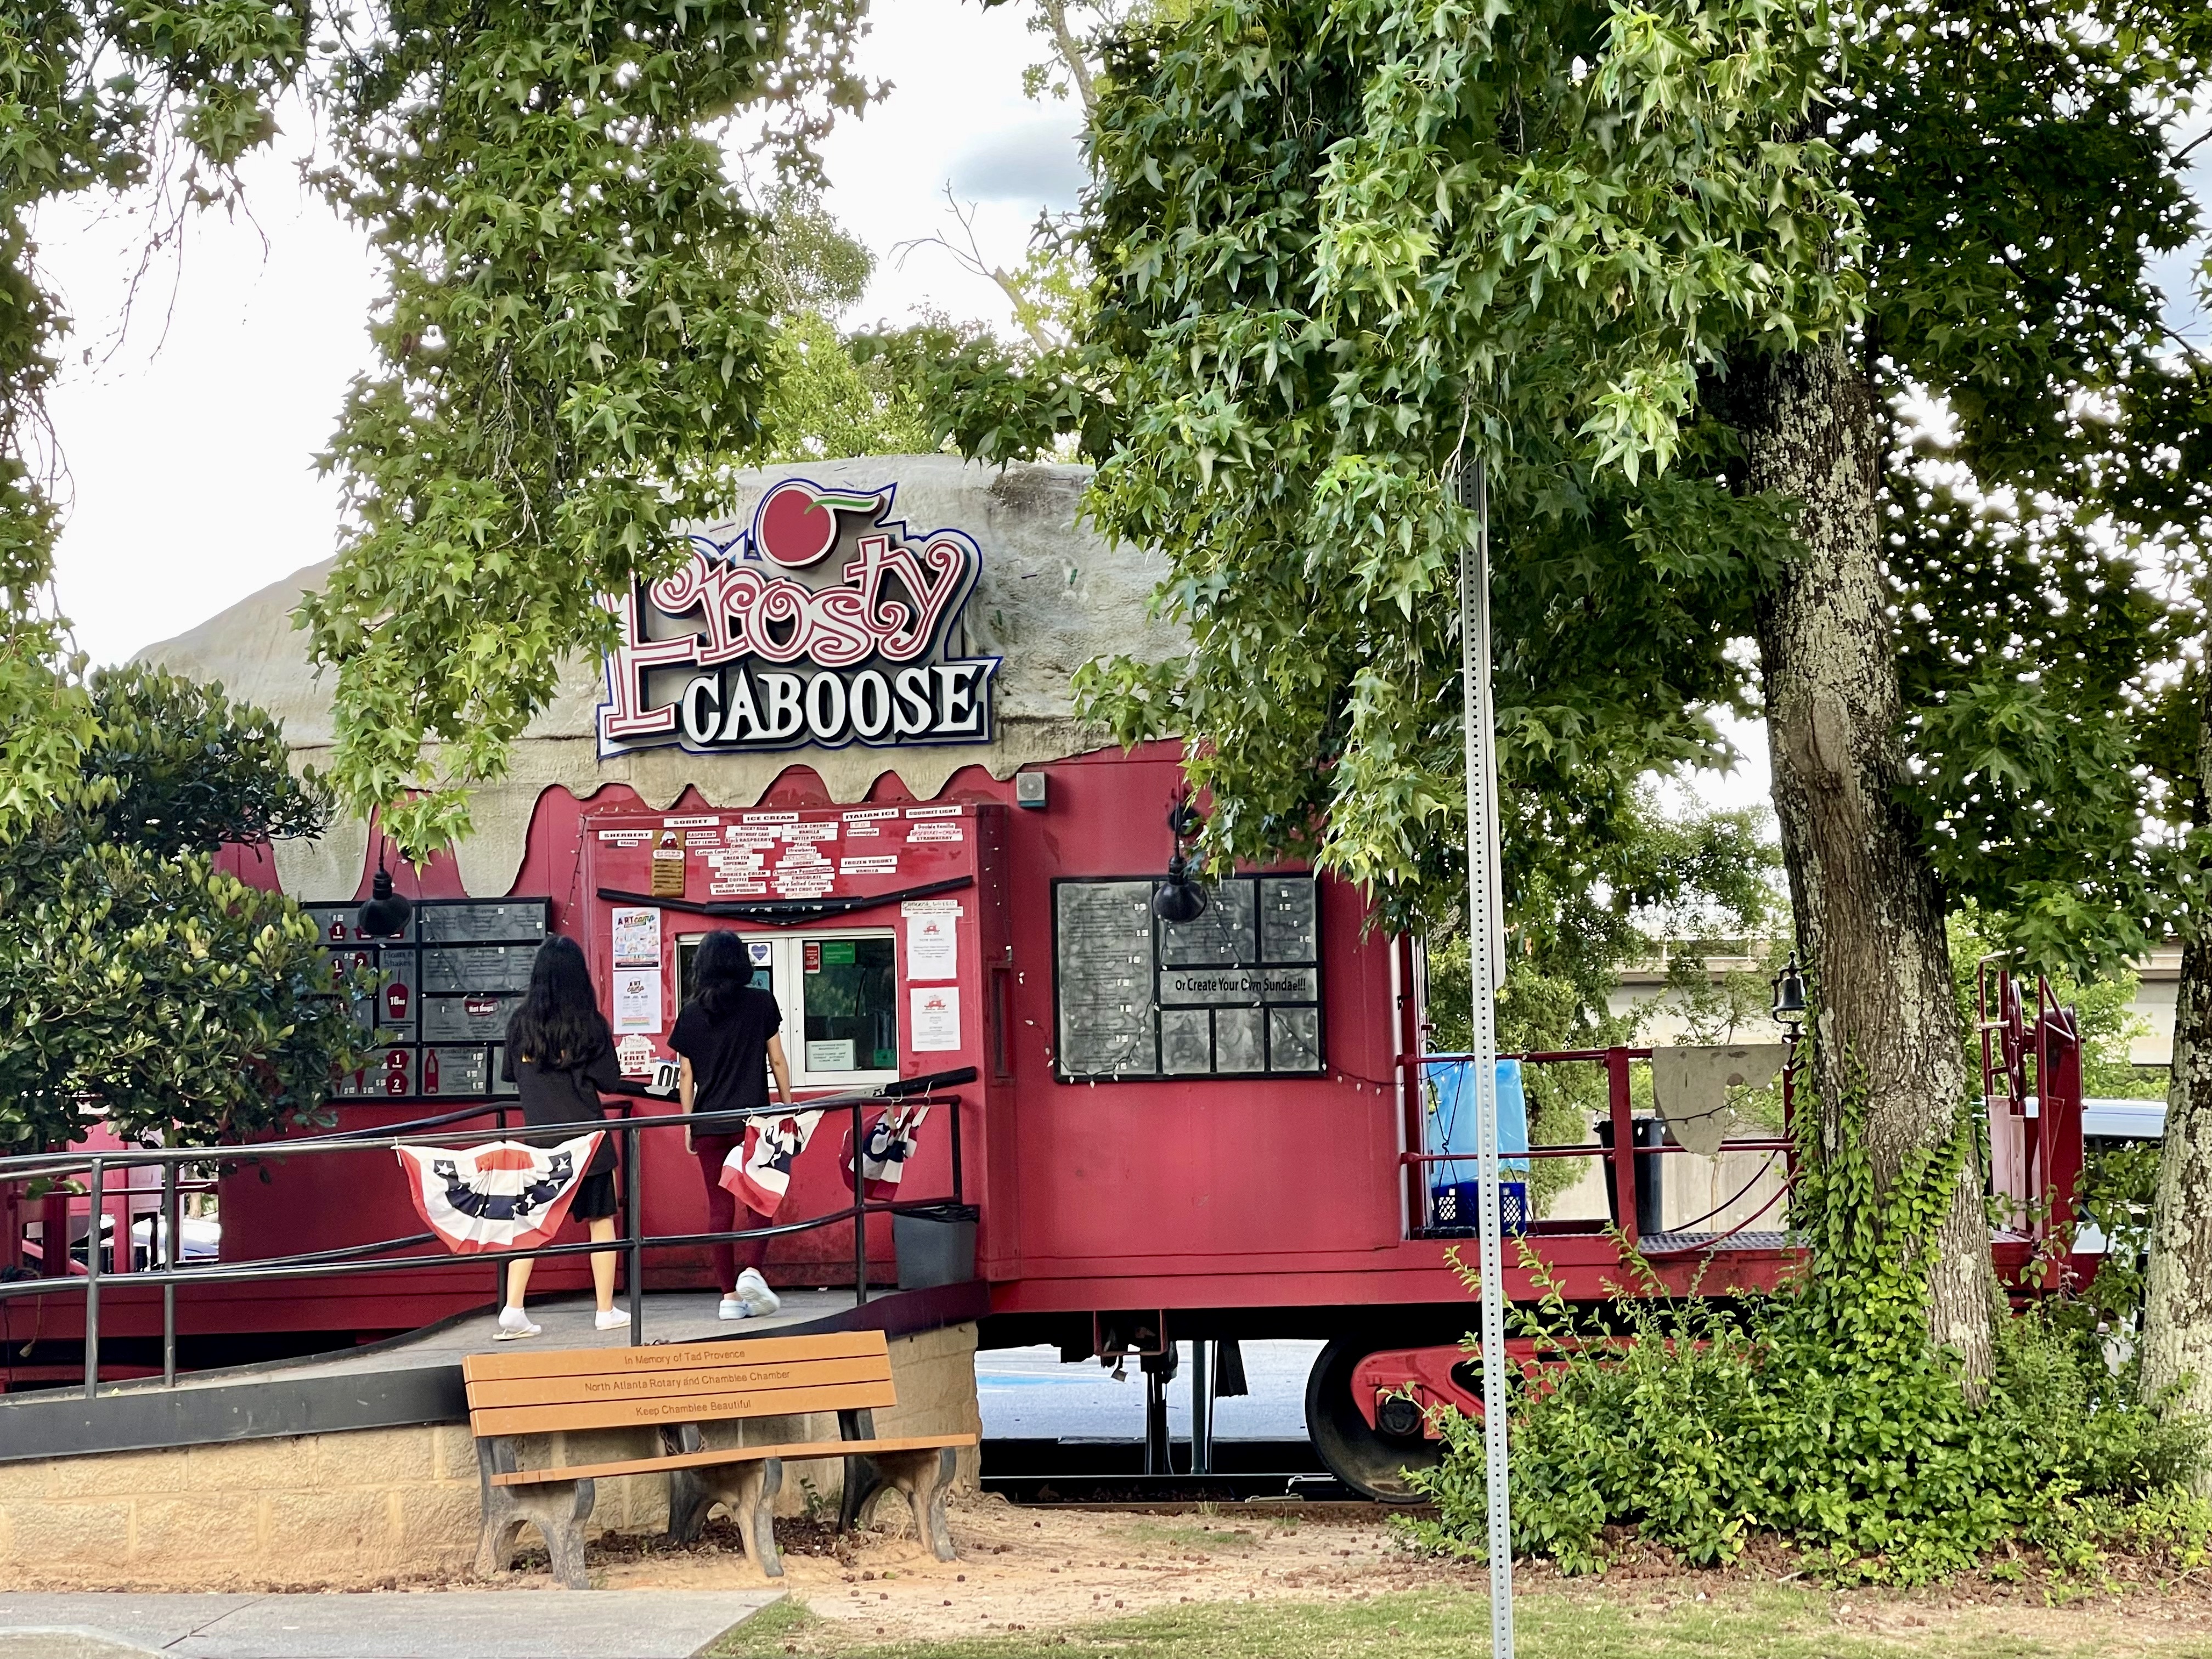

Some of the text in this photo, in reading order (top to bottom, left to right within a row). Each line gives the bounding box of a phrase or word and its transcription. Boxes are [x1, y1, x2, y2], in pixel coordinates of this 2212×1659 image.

[606, 534, 966, 740] Frosty
[681, 663, 982, 744] CABOOSE
[618, 915, 656, 926] ART camp
[1175, 977, 1306, 992] Or Create Your Own Sundae!!!
[395, 1054, 400, 1064] 1
[393, 1079, 400, 1088] 2
[624, 1350, 745, 1365] In Memory of Tad Provence
[585, 1370, 790, 1392] North Atlanta Rotary and Chamblee Chamber
[636, 1400, 751, 1417] Keep Chamblee Beautiful
